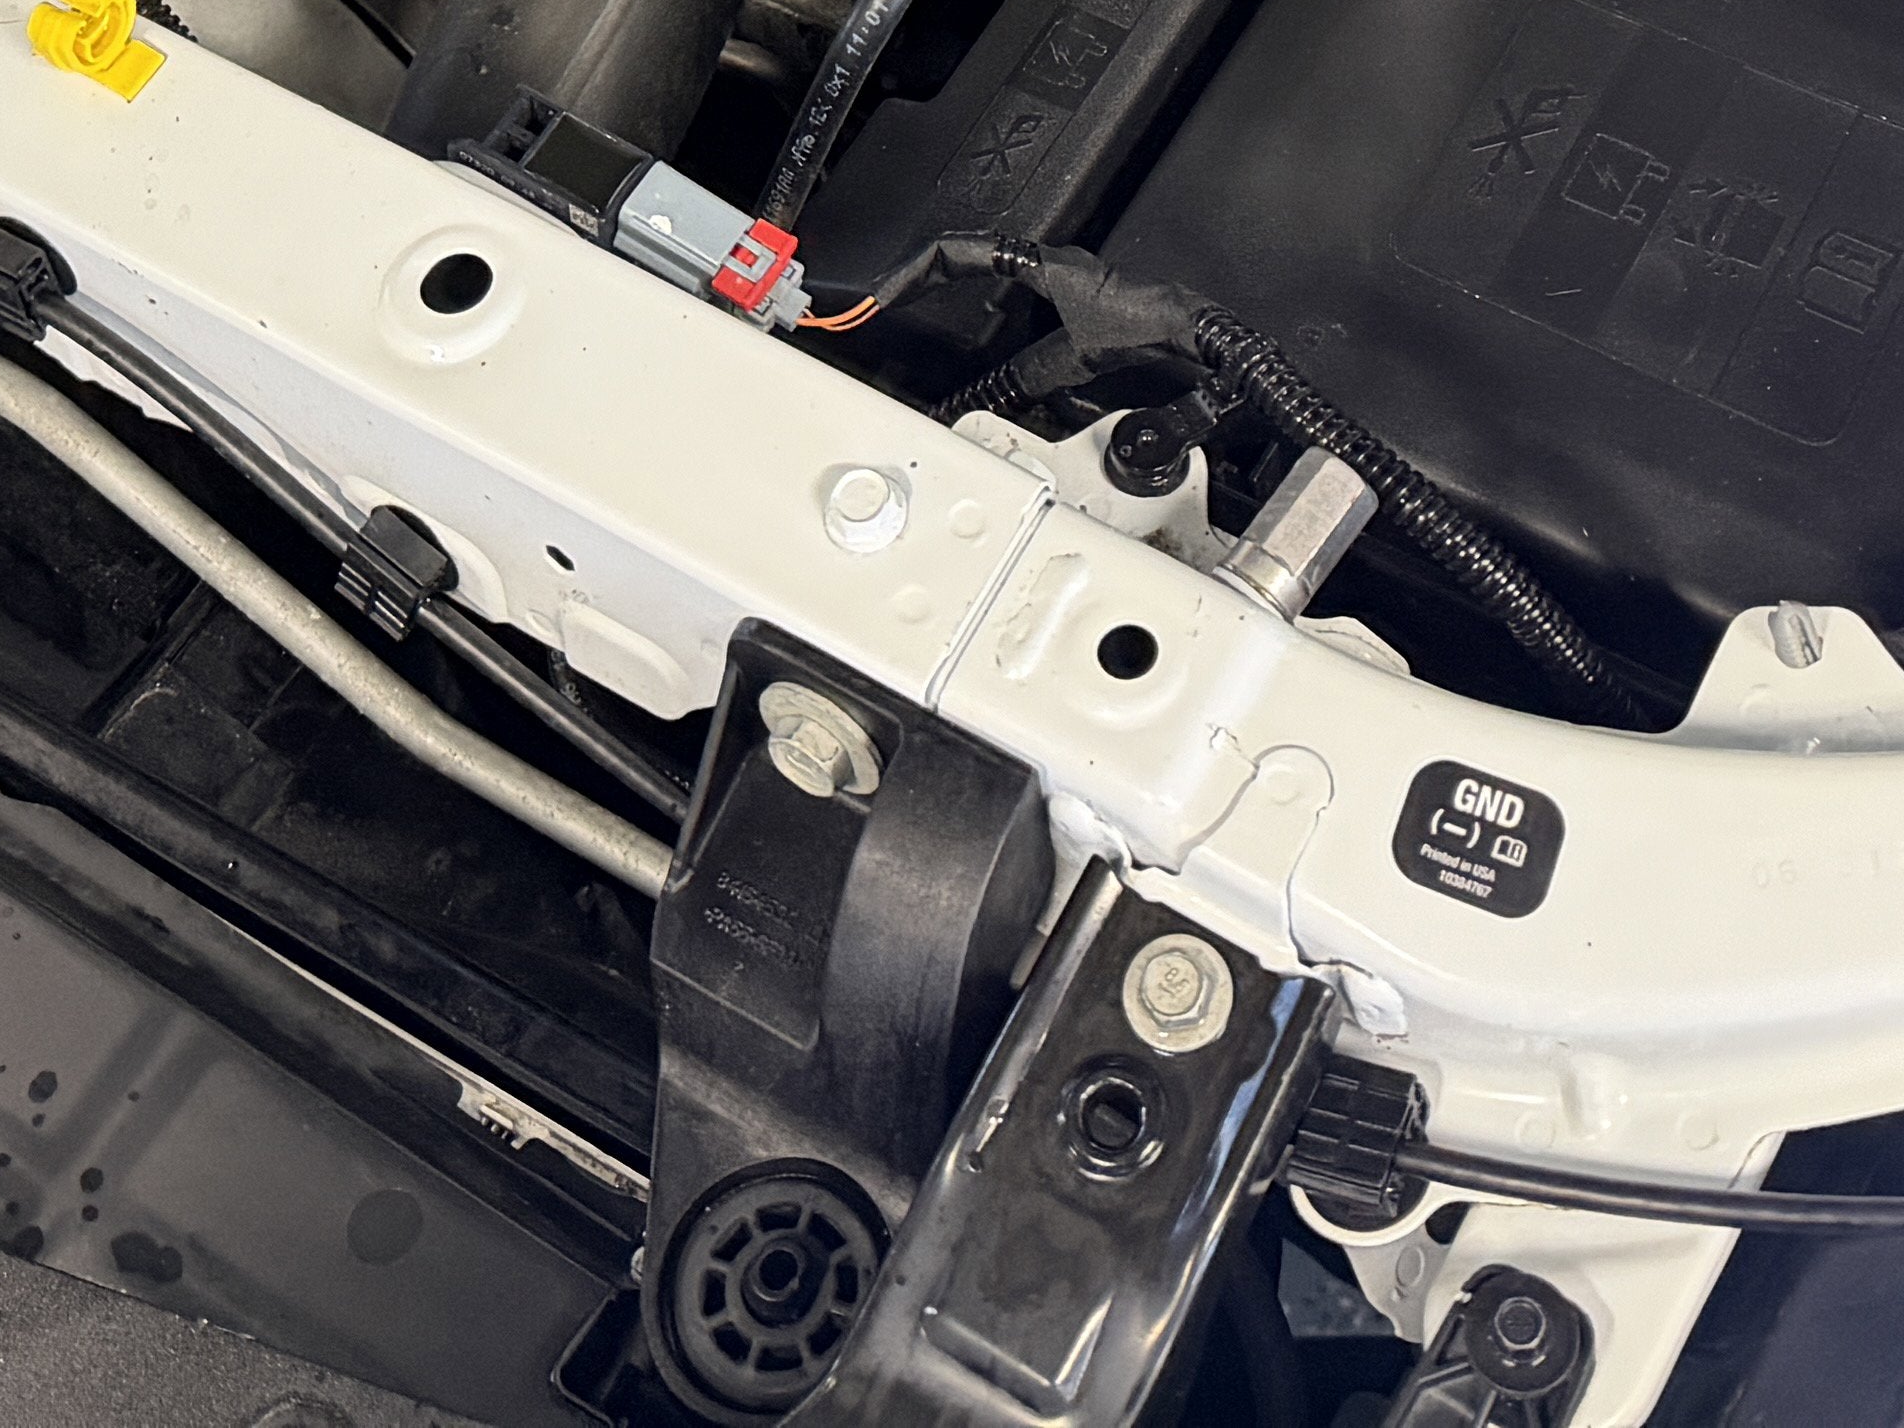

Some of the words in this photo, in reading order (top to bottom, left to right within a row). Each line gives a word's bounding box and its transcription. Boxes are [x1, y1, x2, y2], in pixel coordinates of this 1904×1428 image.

[1453, 777, 1526, 830] GND
[1419, 843, 1461, 870] Printed
[1458, 855, 1473, 873] in
[1472, 861, 1497, 883] USA
